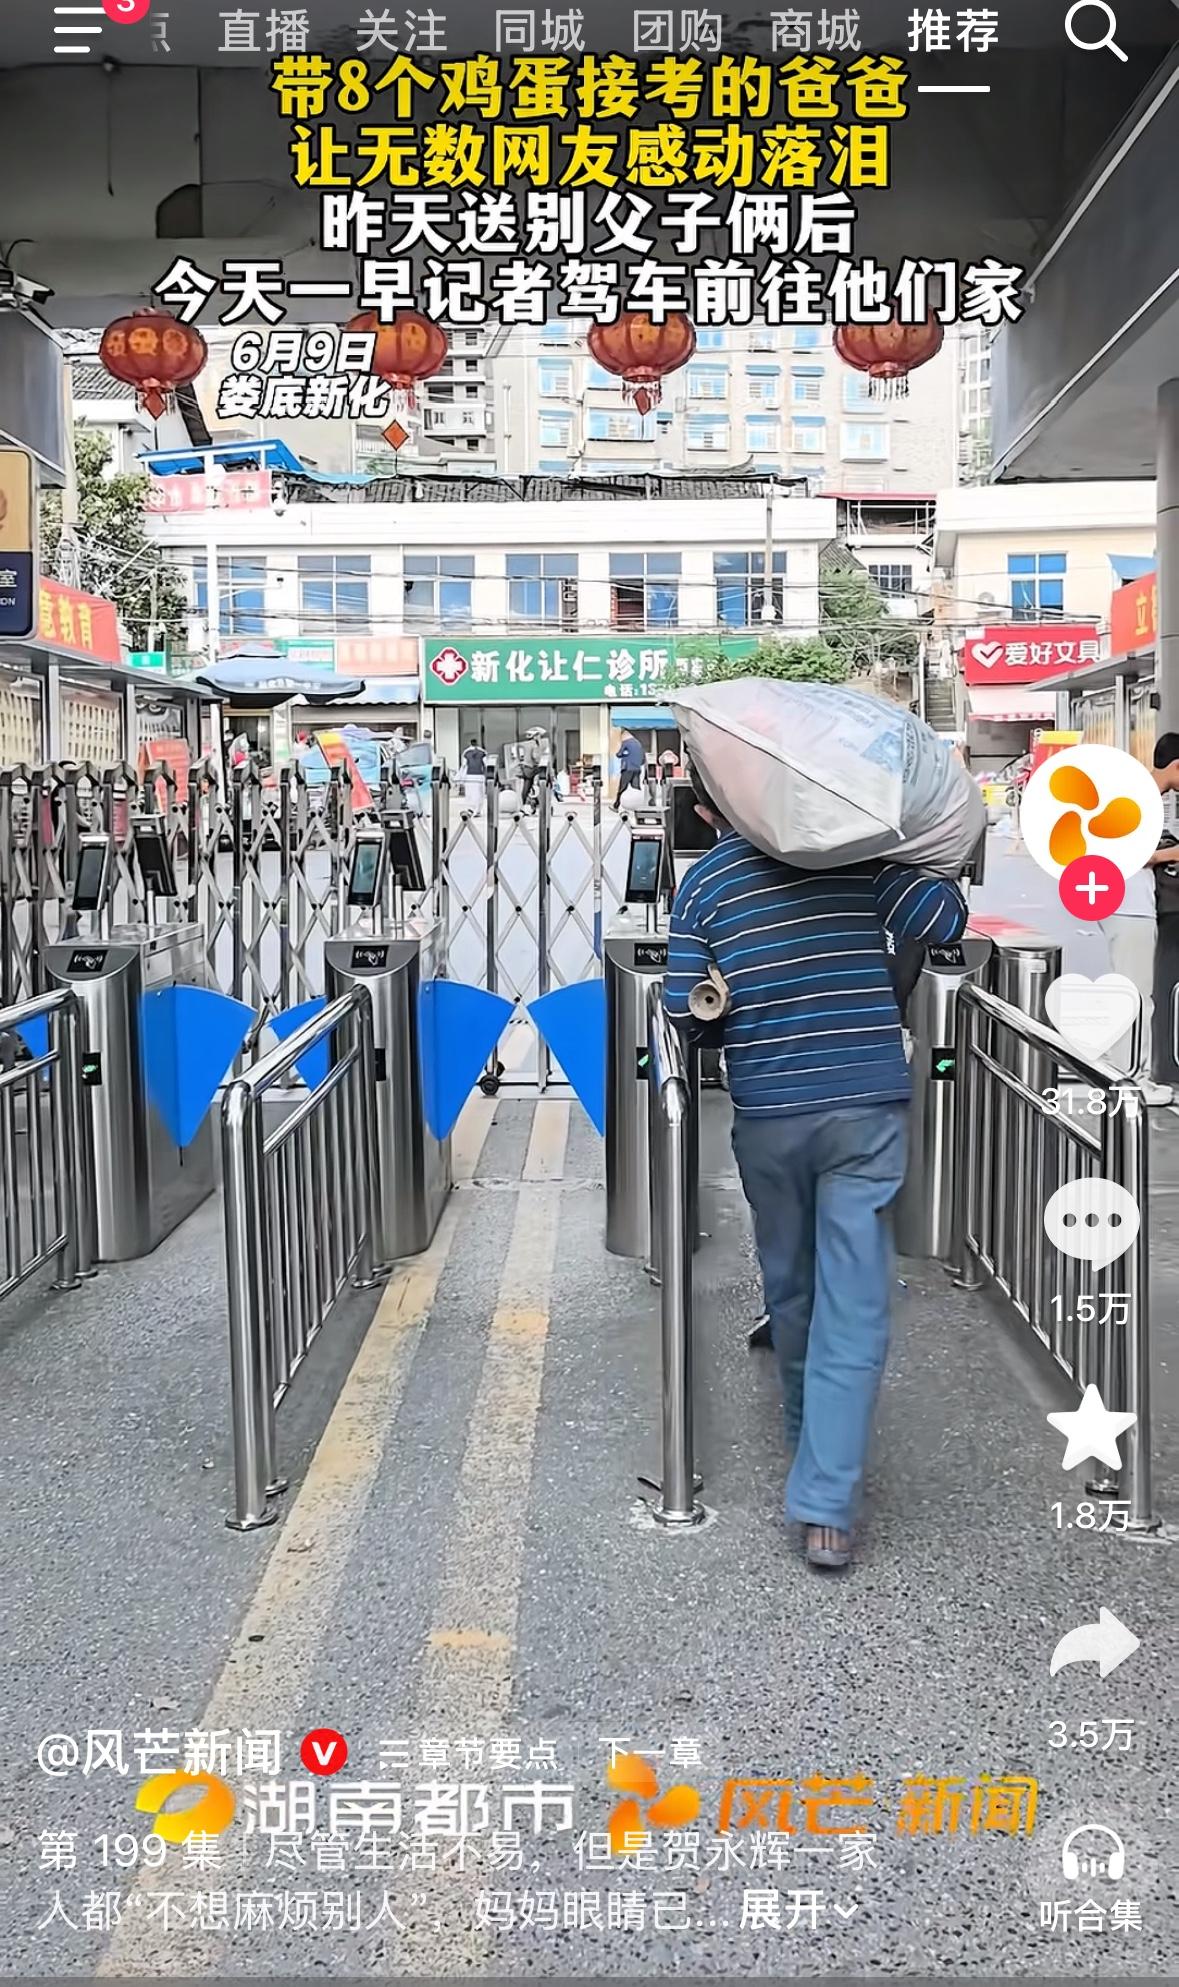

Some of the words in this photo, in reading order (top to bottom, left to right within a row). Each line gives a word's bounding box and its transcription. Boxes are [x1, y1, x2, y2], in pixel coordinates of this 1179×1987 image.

[470, 648, 668, 683] 新化让仁诊所
[1004, 640, 1100, 666] 爱好文具
